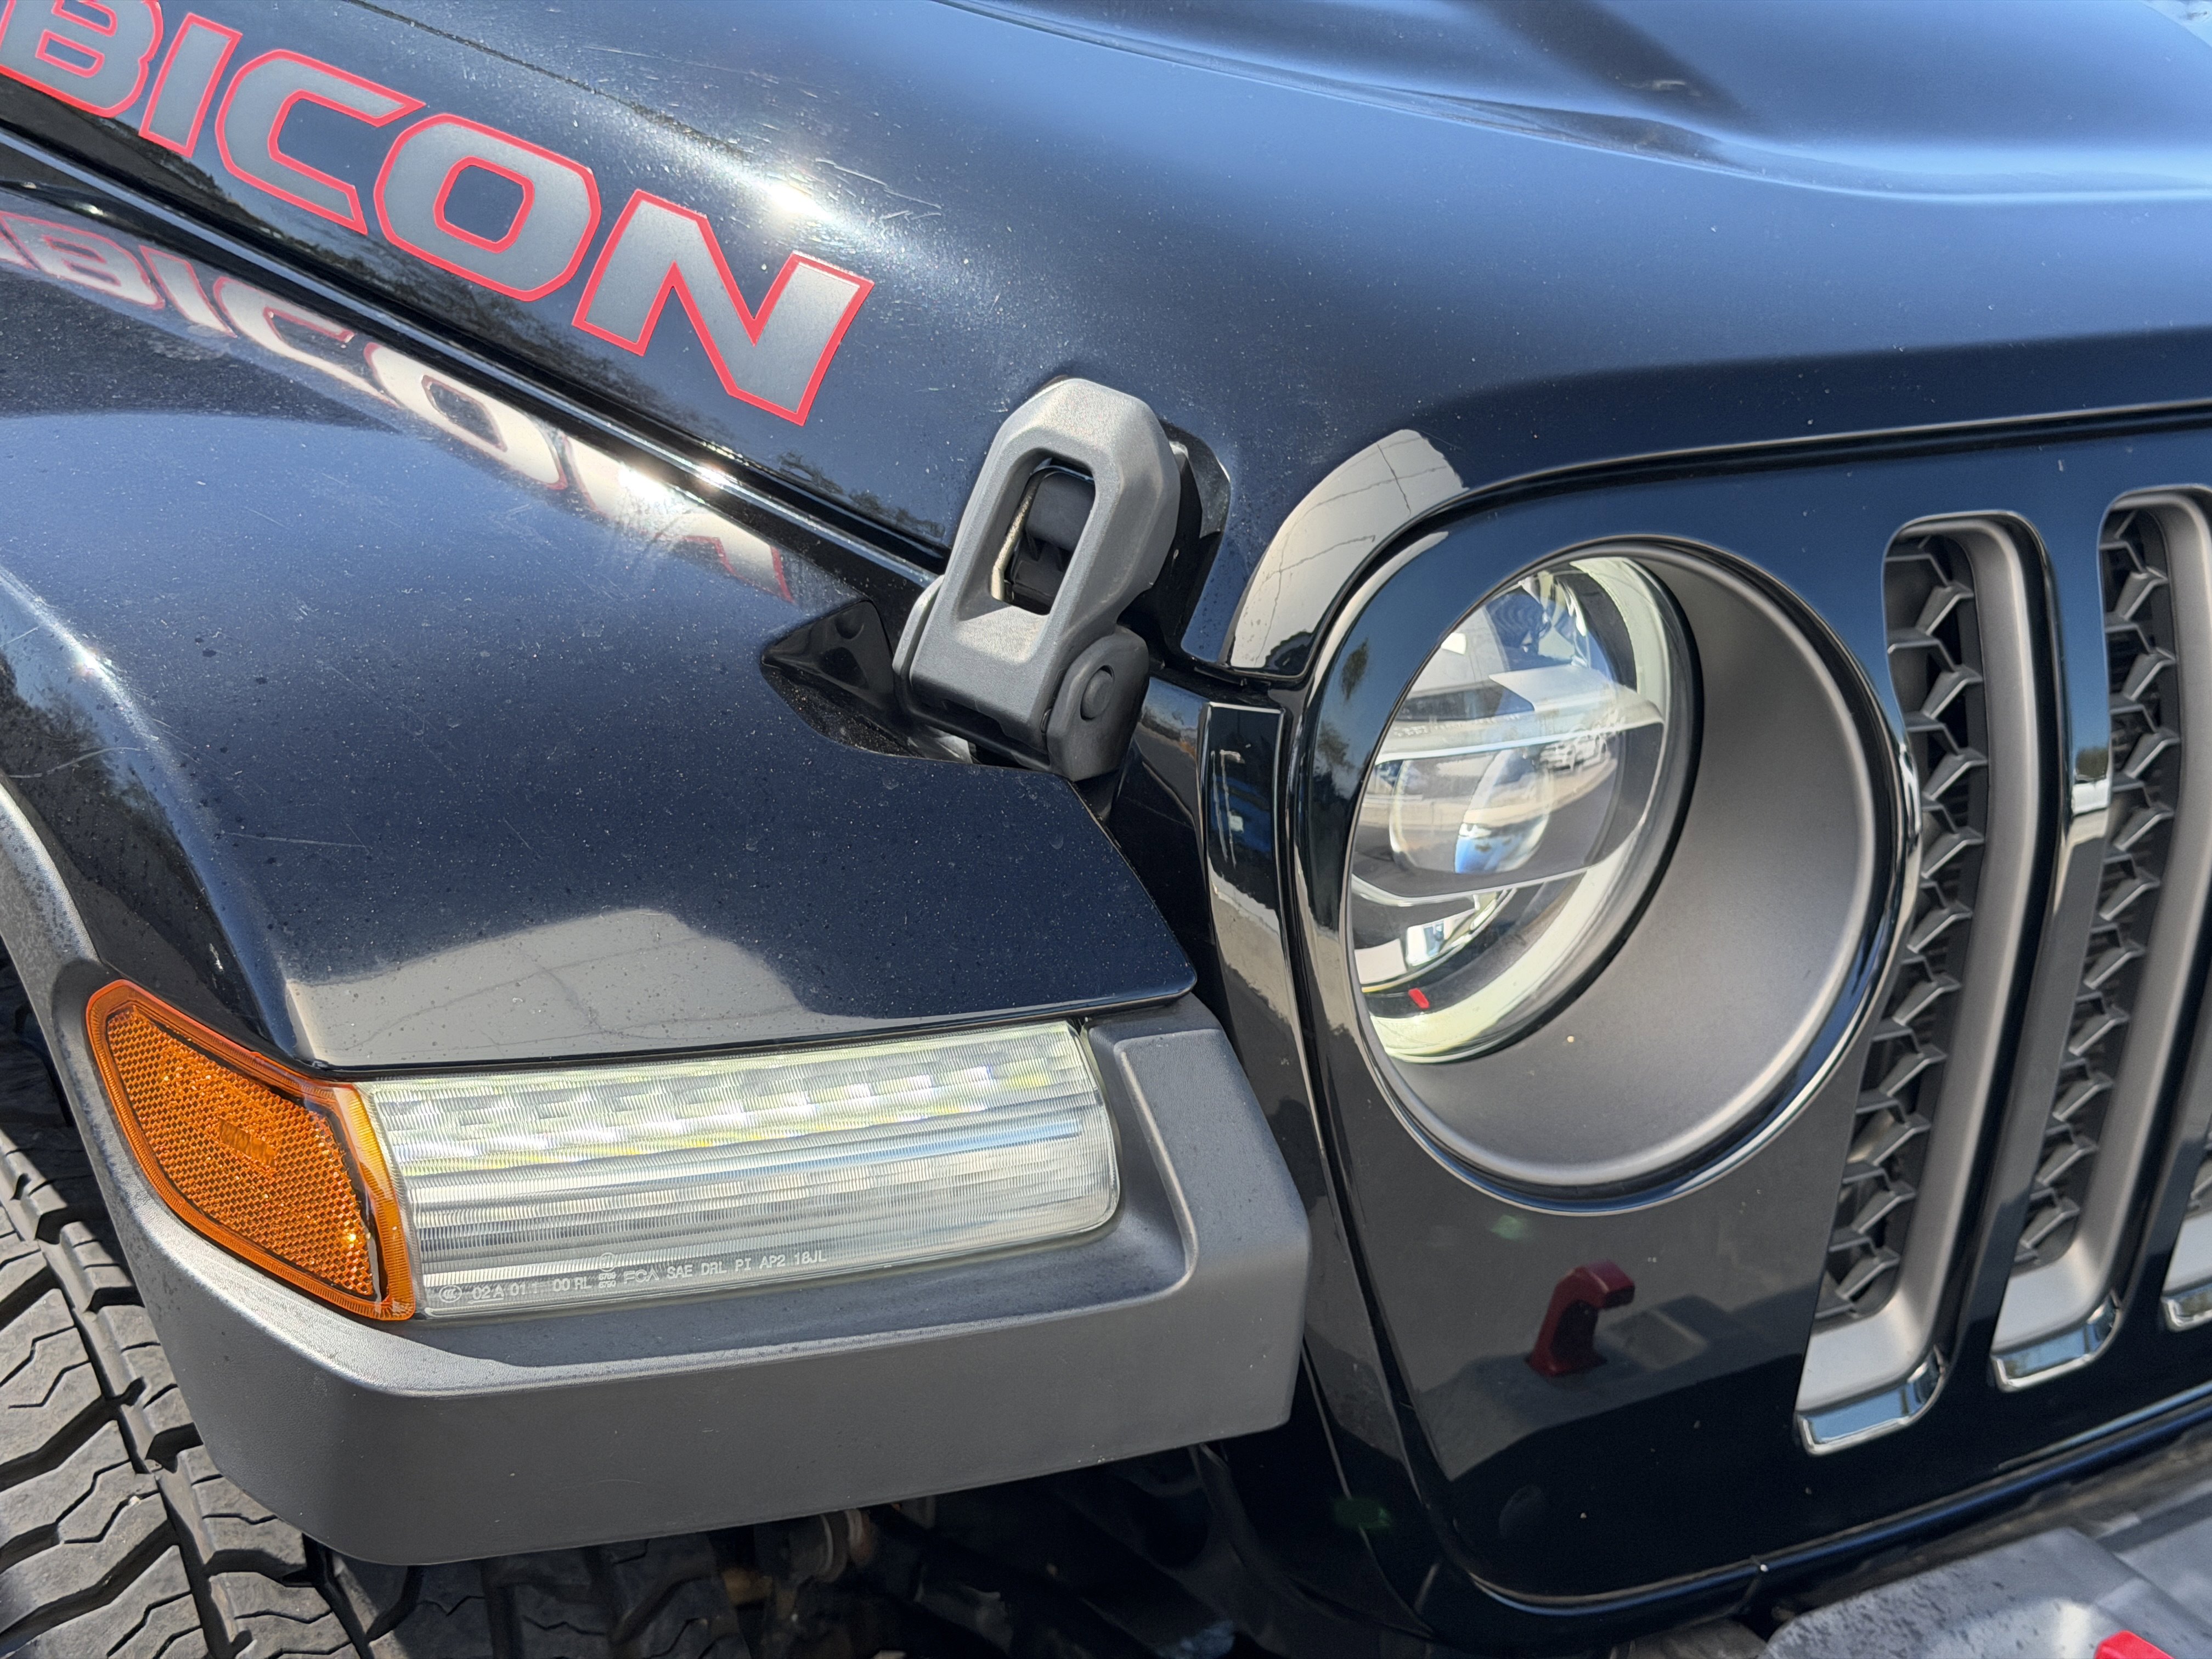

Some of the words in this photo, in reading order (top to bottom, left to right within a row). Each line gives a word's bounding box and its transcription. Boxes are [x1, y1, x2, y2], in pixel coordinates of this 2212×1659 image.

[623, 1267, 660, 1284] FCA
[667, 1264, 693, 1279] SAE
[701, 1261, 727, 1276] DRL
[735, 1257, 752, 1272] PI
[759, 1254, 786, 1269] AP2
